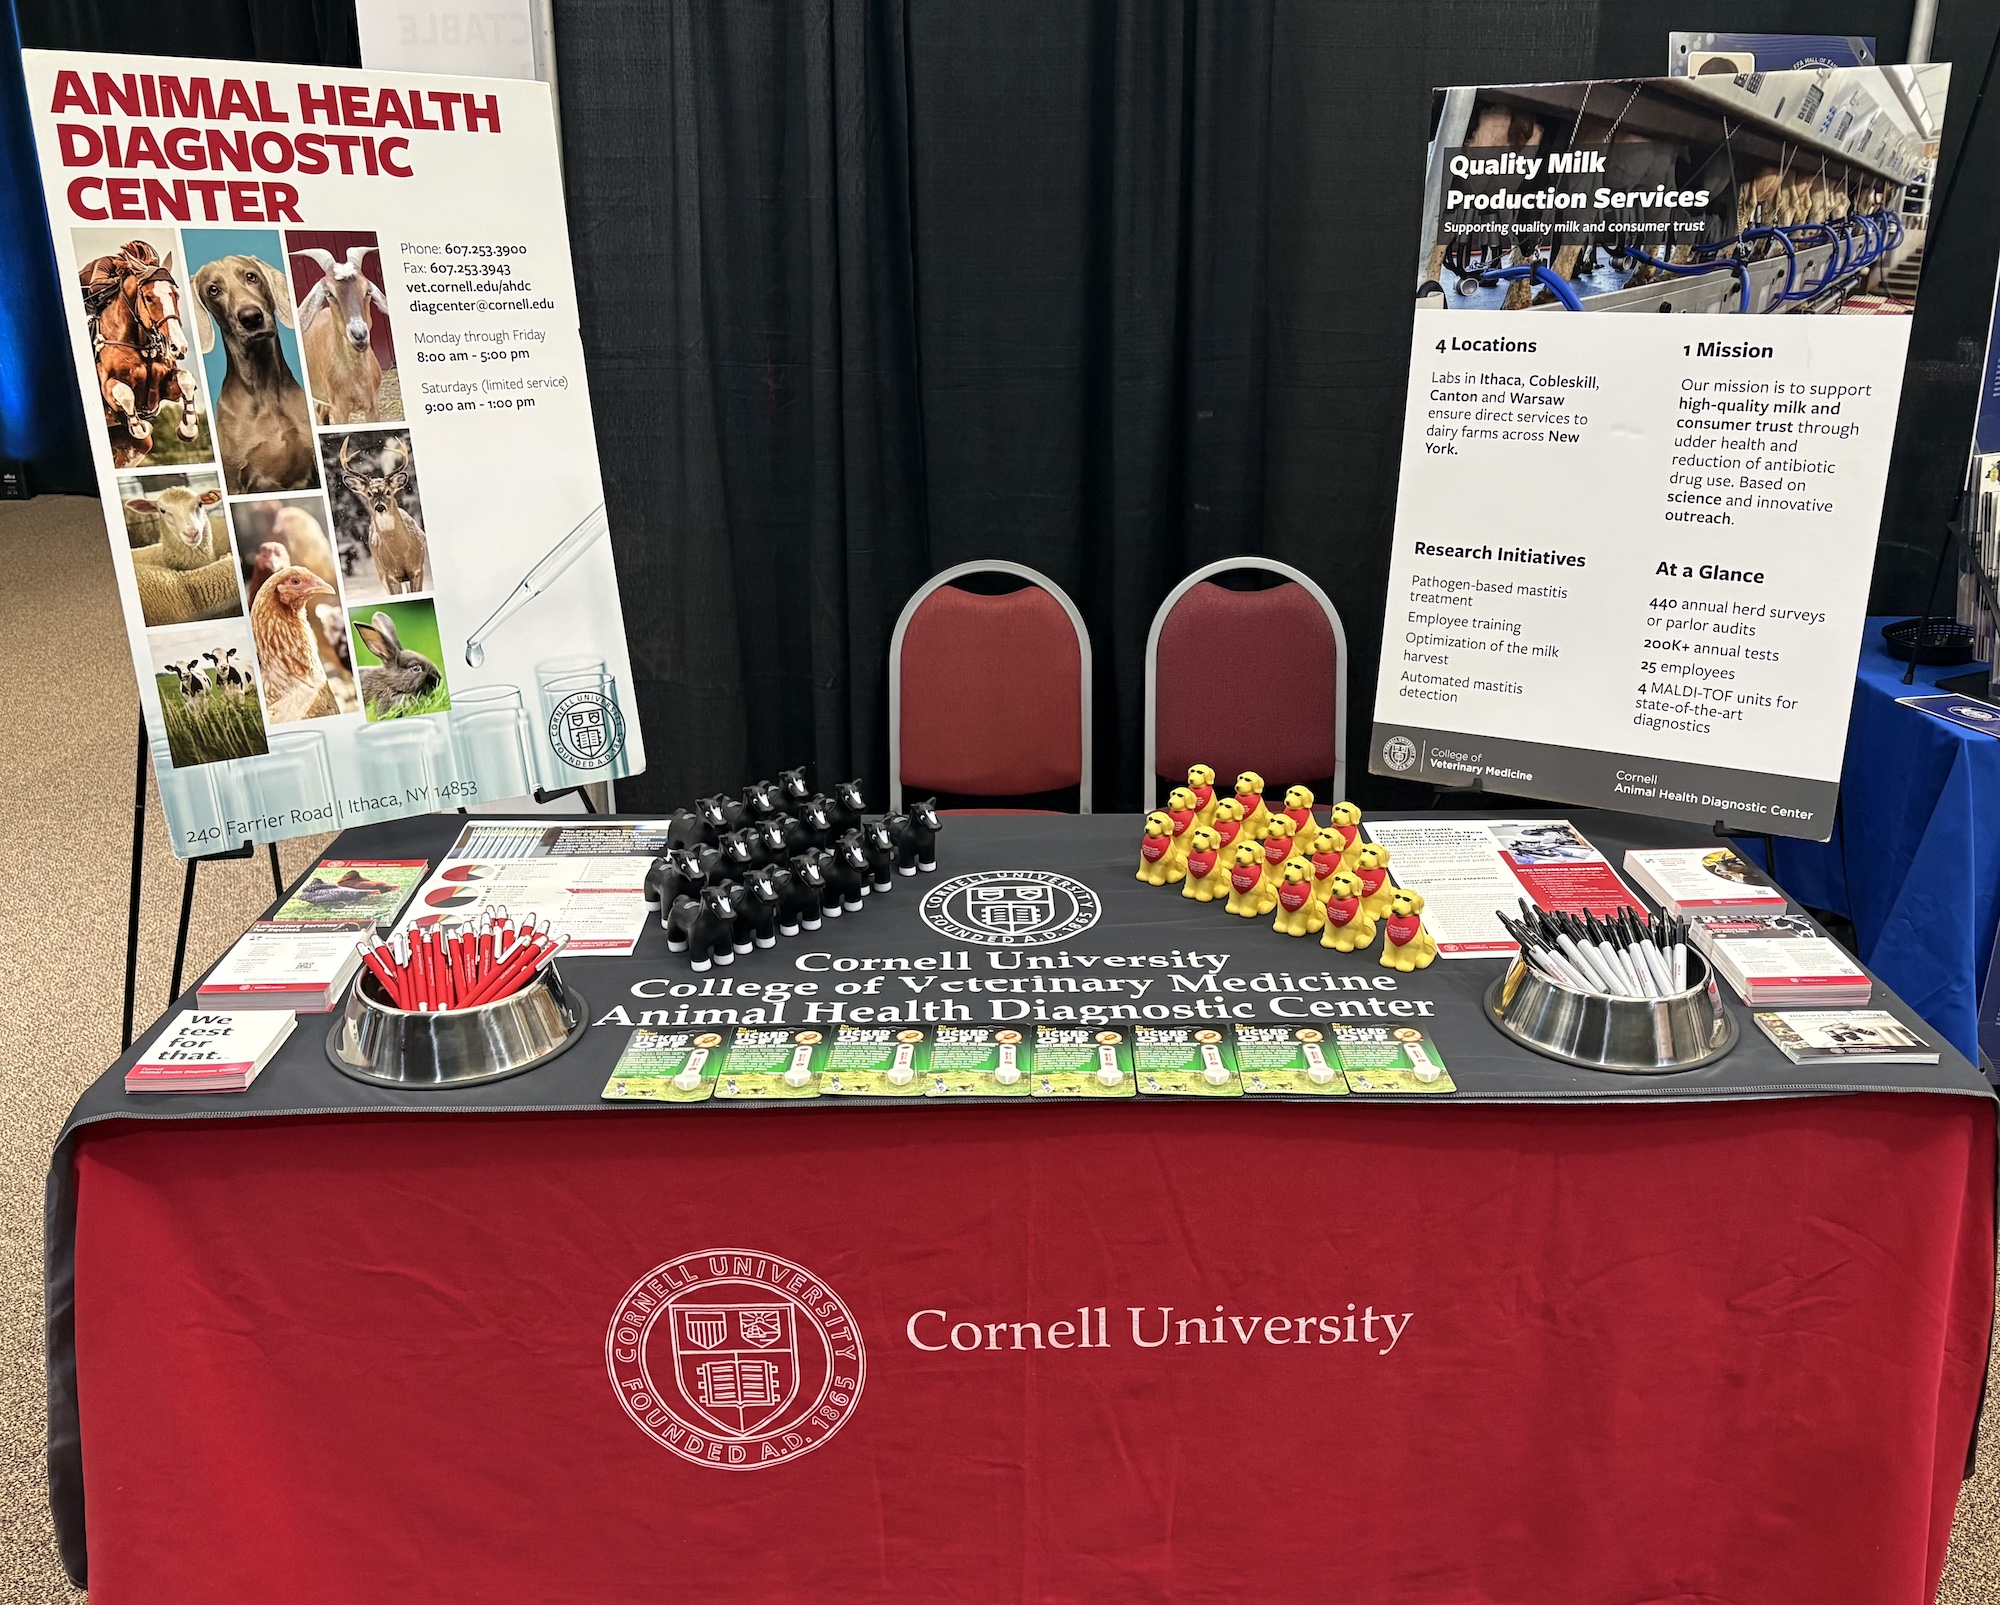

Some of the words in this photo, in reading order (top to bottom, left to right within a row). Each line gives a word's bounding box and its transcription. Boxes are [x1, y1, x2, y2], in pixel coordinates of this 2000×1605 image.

[51, 71, 288, 124] ANIMAL
[299, 84, 501, 133] HEALTH
[58, 124, 414, 177] DIAGNOSTIC
[1450, 152, 1542, 179] Quality
[1548, 150, 1607, 174] Milk
[66, 176, 304, 223] CENTER
[1446, 188, 1587, 210] Production
[1594, 184, 1710, 208] Services
[1444, 221, 1508, 235] Supporting
[1512, 221, 1552, 235] quality
[1554, 220, 1580, 232] milk
[1582, 220, 1606, 232] and
[1608, 222, 1672, 232] consumer
[1674, 220, 1705, 232] trust
[401, 242, 441, 254] Phone:
[445, 243, 527, 256] 607.253.3900
[404, 262, 427, 274] Fax:
[430, 262, 511, 275] 607.253.3943
[406, 280, 531, 294] vet.cornell.edu/ahdc
[409, 298, 554, 315] diagcenter@cornell.edu
[414, 332, 460, 346] Monday
[465, 331, 509, 344] through
[513, 329, 546, 343] Friday
[1436, 340, 1446, 353] 4
[1452, 337, 1537, 353] Locations
[417, 352, 445, 362] 8:00
[450, 352, 468, 361] am
[481, 351, 507, 362] 5:00
[511, 350, 529, 361] pm
[1683, 346, 1690, 356] 1
[1697, 342, 1773, 358] Mission
[422, 381, 478, 395] Saturdays
[482, 378, 523, 394] (limited
[527, 376, 568, 390] service)
[1432, 372, 1461, 384] Labs
[1465, 373, 1476, 384] in
[1480, 373, 1525, 388] Ithaca,
[1529, 375, 1600, 391] Cobleskill,
[1682, 379, 1709, 391] Our
[1714, 380, 1769, 393] mission
[1774, 381, 1785, 394] is
[1790, 383, 1805, 394] to
[1810, 384, 1872, 399] support
[425, 403, 453, 414] 9:00
[458, 401, 476, 410] am
[488, 400, 512, 408] 1:00
[517, 398, 535, 410] pm
[1430, 390, 1477, 402] Canton
[1482, 392, 1505, 403] and
[1510, 393, 1565, 406] Warsaw
[1679, 397, 1769, 415] high-quality
[1773, 400, 1806, 413] milk
[1811, 402, 1841, 415] and
[1428, 410, 1472, 420] ensure
[1475, 409, 1513, 422] direct
[1517, 413, 1570, 425] services
[1574, 414, 1588, 425] to
[1427, 425, 1458, 440] dairy
[1462, 426, 1498, 439] farms
[1502, 430, 1544, 441] across
[1548, 431, 1580, 443] New
[1677, 419, 1752, 431] consumer
[1756, 420, 1793, 433] trust
[1798, 421, 1859, 439] through
[1426, 443, 1458, 455] York.
[1667, 491, 1722, 505] science
[1726, 495, 1752, 507] and
[1757, 496, 1833, 512] innovative
[1665, 510, 1734, 525] outreach.
[1414, 542, 1492, 560] Research
[1498, 548, 1586, 567] Initiatives
[1656, 562, 1677, 576] At
[1683, 567, 1693, 577] a
[1699, 565, 1764, 583] Glance
[1412, 575, 1513, 594] Pathogen-based
[1517, 584, 1568, 599] mastitis
[1410, 592, 1473, 607] treatment
[1649, 598, 1677, 610] 440
[1682, 600, 1728, 613] annual
[1732, 602, 1765, 616] herd
[1770, 609, 1826, 625] surveys
[1408, 612, 1469, 629] Employee
[1472, 618, 1522, 636] training
[1647, 617, 1662, 626] or
[1666, 618, 1709, 631] parlor
[1713, 622, 1756, 636] audits
[1406, 632, 1486, 650] Optimization
[1490, 640, 1504, 651] of
[1507, 643, 1528, 654] the
[1532, 644, 1559, 658] milk
[1644, 639, 1690, 652] 200K+
[1694, 644, 1740, 657] annual
[1745, 649, 1779, 661] tests
[1404, 650, 1449, 665] harvest
[1641, 661, 1657, 673] 25
[1661, 663, 1735, 681] employees
[1401, 671, 1469, 688] Automated
[1473, 679, 1523, 694] mastitis
[1399, 686, 1458, 703] detection
[1638, 683, 1647, 695] 4
[1651, 682, 1733, 701] MALDI-TOF
[1737, 693, 1771, 707] units
[1776, 696, 1798, 710] for
[1635, 700, 1743, 721] state-of-the-art
[1634, 714, 1711, 734] diagnostics
[1431, 747, 1468, 761] College
[1471, 754, 1482, 762] of
[1430, 759, 1483, 774] Veterinary
[1486, 766, 1533, 781] Medicine
[1616, 770, 1658, 784] Cornell
[187, 828, 222, 845] 240
[227, 813, 286, 837] Farrier
[291, 802, 333, 823] Road
[349, 790, 403, 814] Ithaca,
[407, 784, 430, 802] NY
[433, 779, 478, 799] 14853
[1614, 784, 1655, 797] Animal
[1659, 789, 1698, 803] Health
[1702, 795, 1766, 814] Diagnostic
[1771, 806, 1813, 820] Center
[795, 951, 981, 972] Cornell
[986, 950, 1230, 975] University
[631, 978, 818, 1002] College
[835, 976, 886, 995] of
[898, 976, 1154, 999] Veterinary
[1171, 972, 1397, 994] Medicine
[192, 1016, 232, 1024] We
[592, 1002, 786, 1028] Animal
[802, 999, 975, 1023] Health
[991, 998, 1258, 1026] Diagnostic
[1269, 996, 1435, 1020] Center
[179, 1028, 234, 1036] test
[168, 1037, 212, 1048] for
[158, 1050, 222, 1060] that.
[616, 1264, 698, 1363] CORNELL
[709, 1257, 856, 1360] UNIVERSITY
[905, 1307, 1112, 1352] Cornell
[1127, 1303, 1414, 1356] University
[622, 1377, 746, 1463] FOUNDED
[762, 1433, 812, 1460] A.D.
[812, 1376, 855, 1430] 1865
